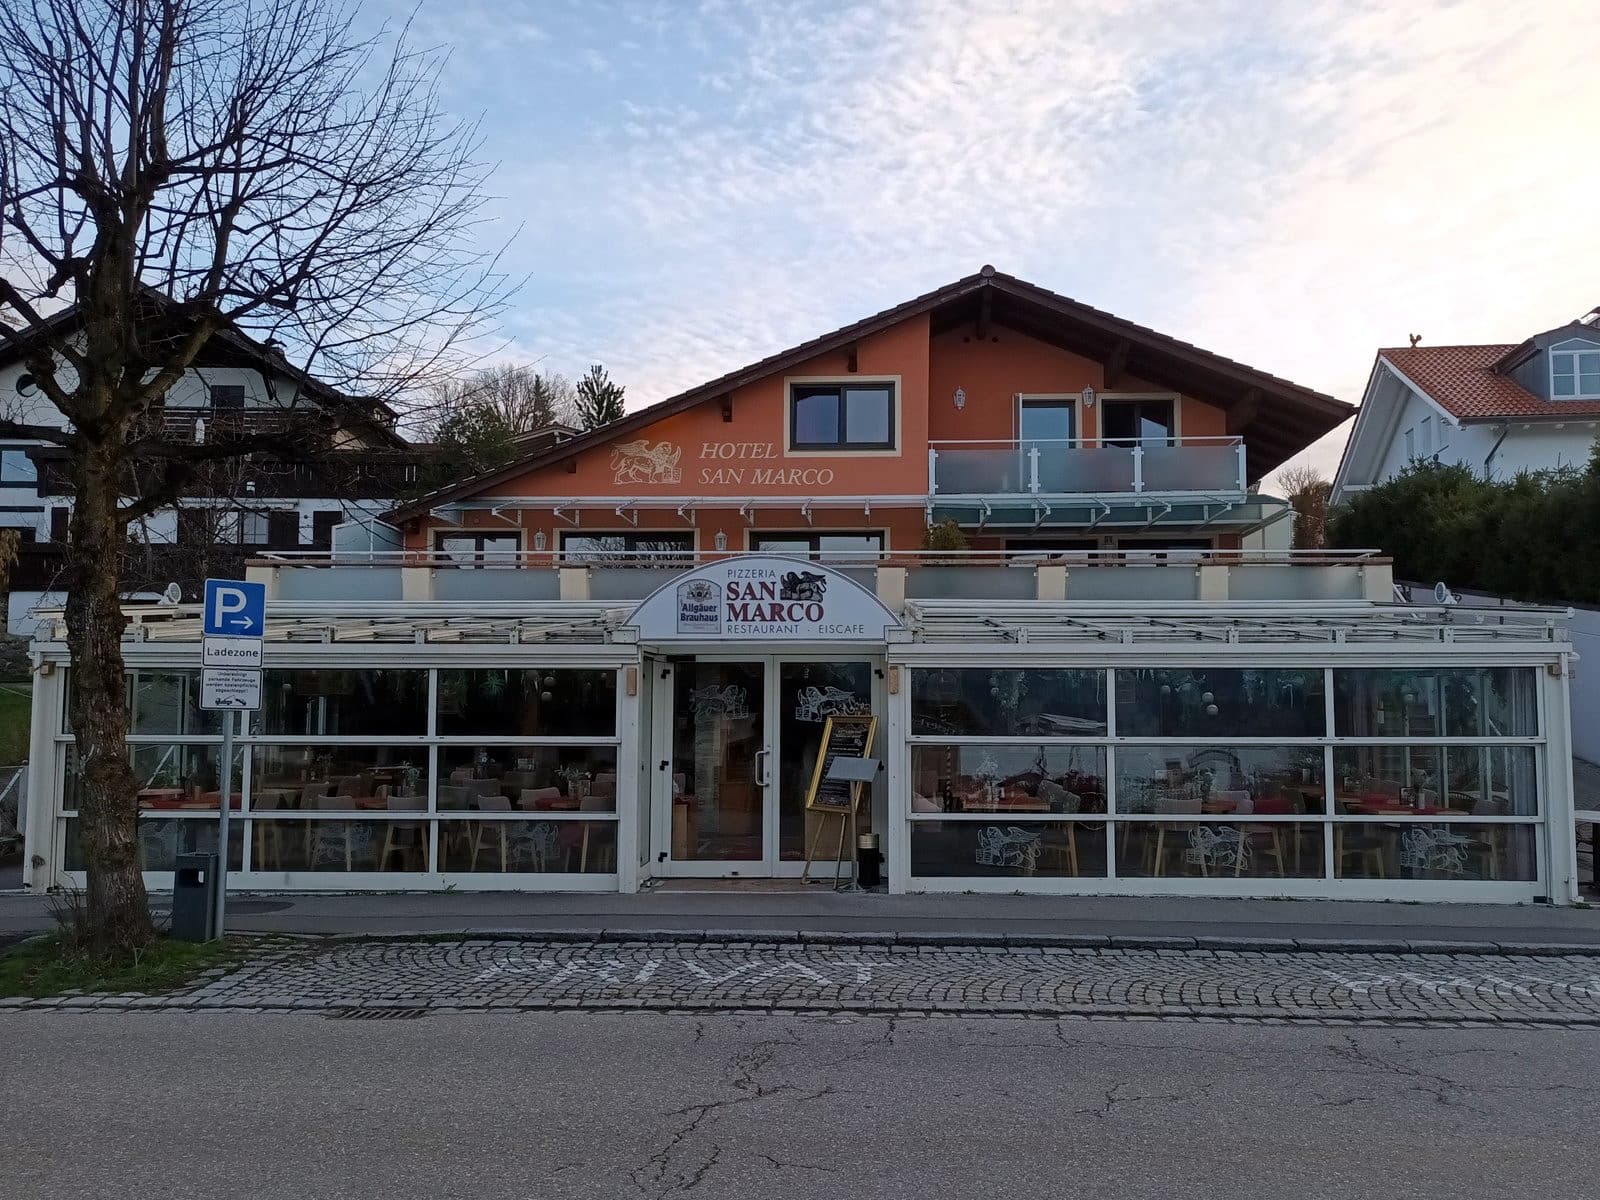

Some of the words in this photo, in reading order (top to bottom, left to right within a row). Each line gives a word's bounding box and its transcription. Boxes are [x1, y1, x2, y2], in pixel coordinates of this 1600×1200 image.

[698, 442, 778, 459] HOTEL
[698, 468, 744, 485] SAN
[750, 468, 834, 485] MARCO
[727, 569, 776, 578] PIZZERIA
[726, 581, 776, 601] SAN
[214, 587, 247, 628] P
[681, 603, 717, 613] Allgäuer
[726, 603, 824, 622] MARCO
[680, 613, 719, 622] Brauhaus
[727, 624, 800, 634] RESTAURANT
[818, 624, 865, 634] EISCAFE
[207, 647, 259, 658] Ladezone
